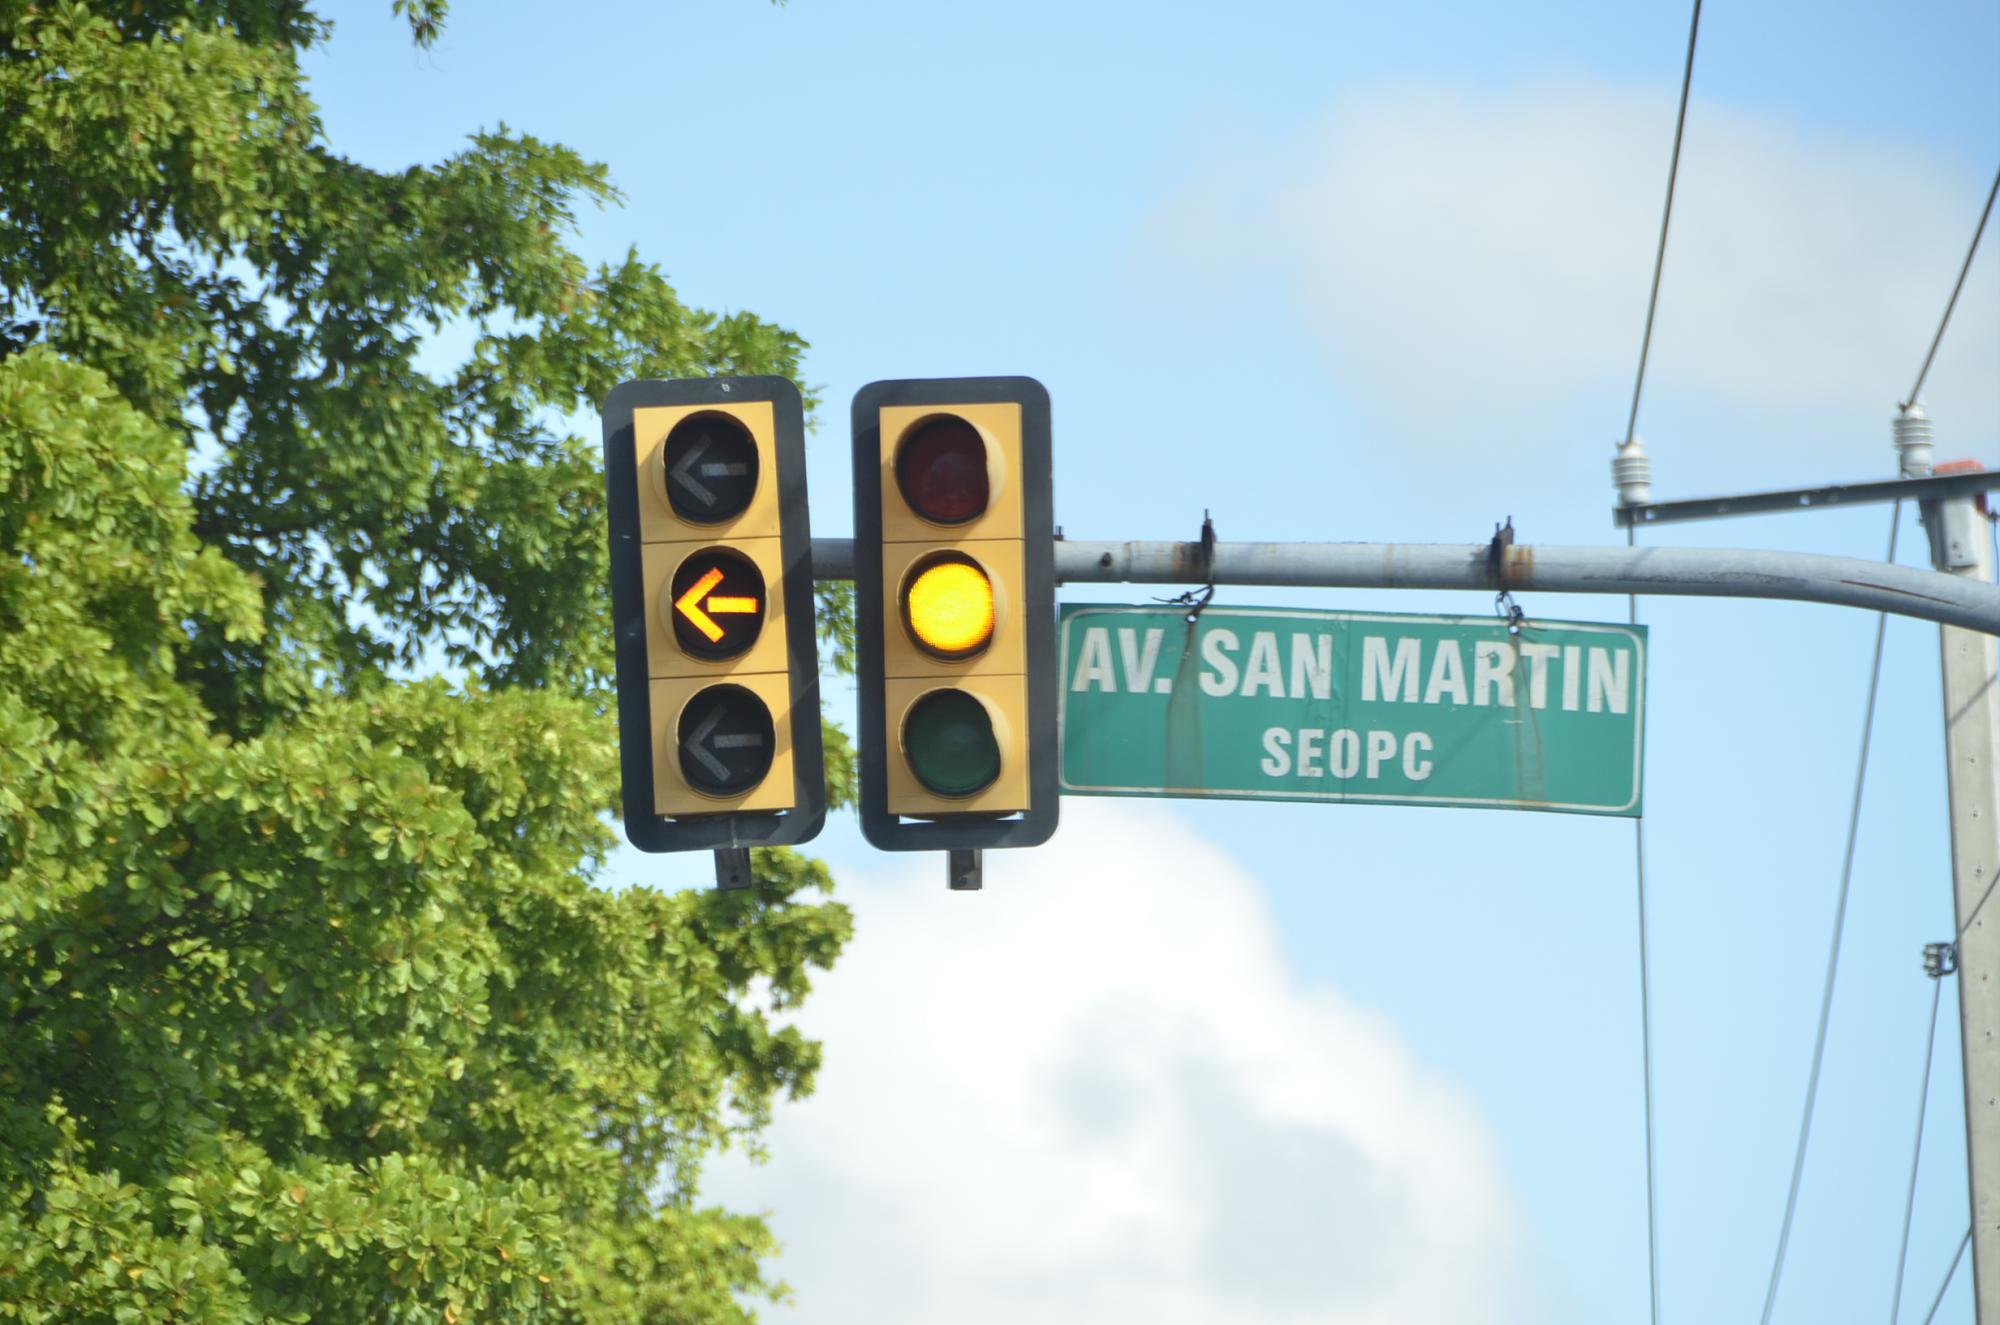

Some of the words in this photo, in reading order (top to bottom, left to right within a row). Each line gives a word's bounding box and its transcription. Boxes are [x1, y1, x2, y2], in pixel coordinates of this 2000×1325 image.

[1071, 627, 1173, 694] AV.
[1198, 628, 1333, 700] SAN
[1361, 635, 1631, 714] MARTIN
[1261, 726, 1434, 781] SEOPC
